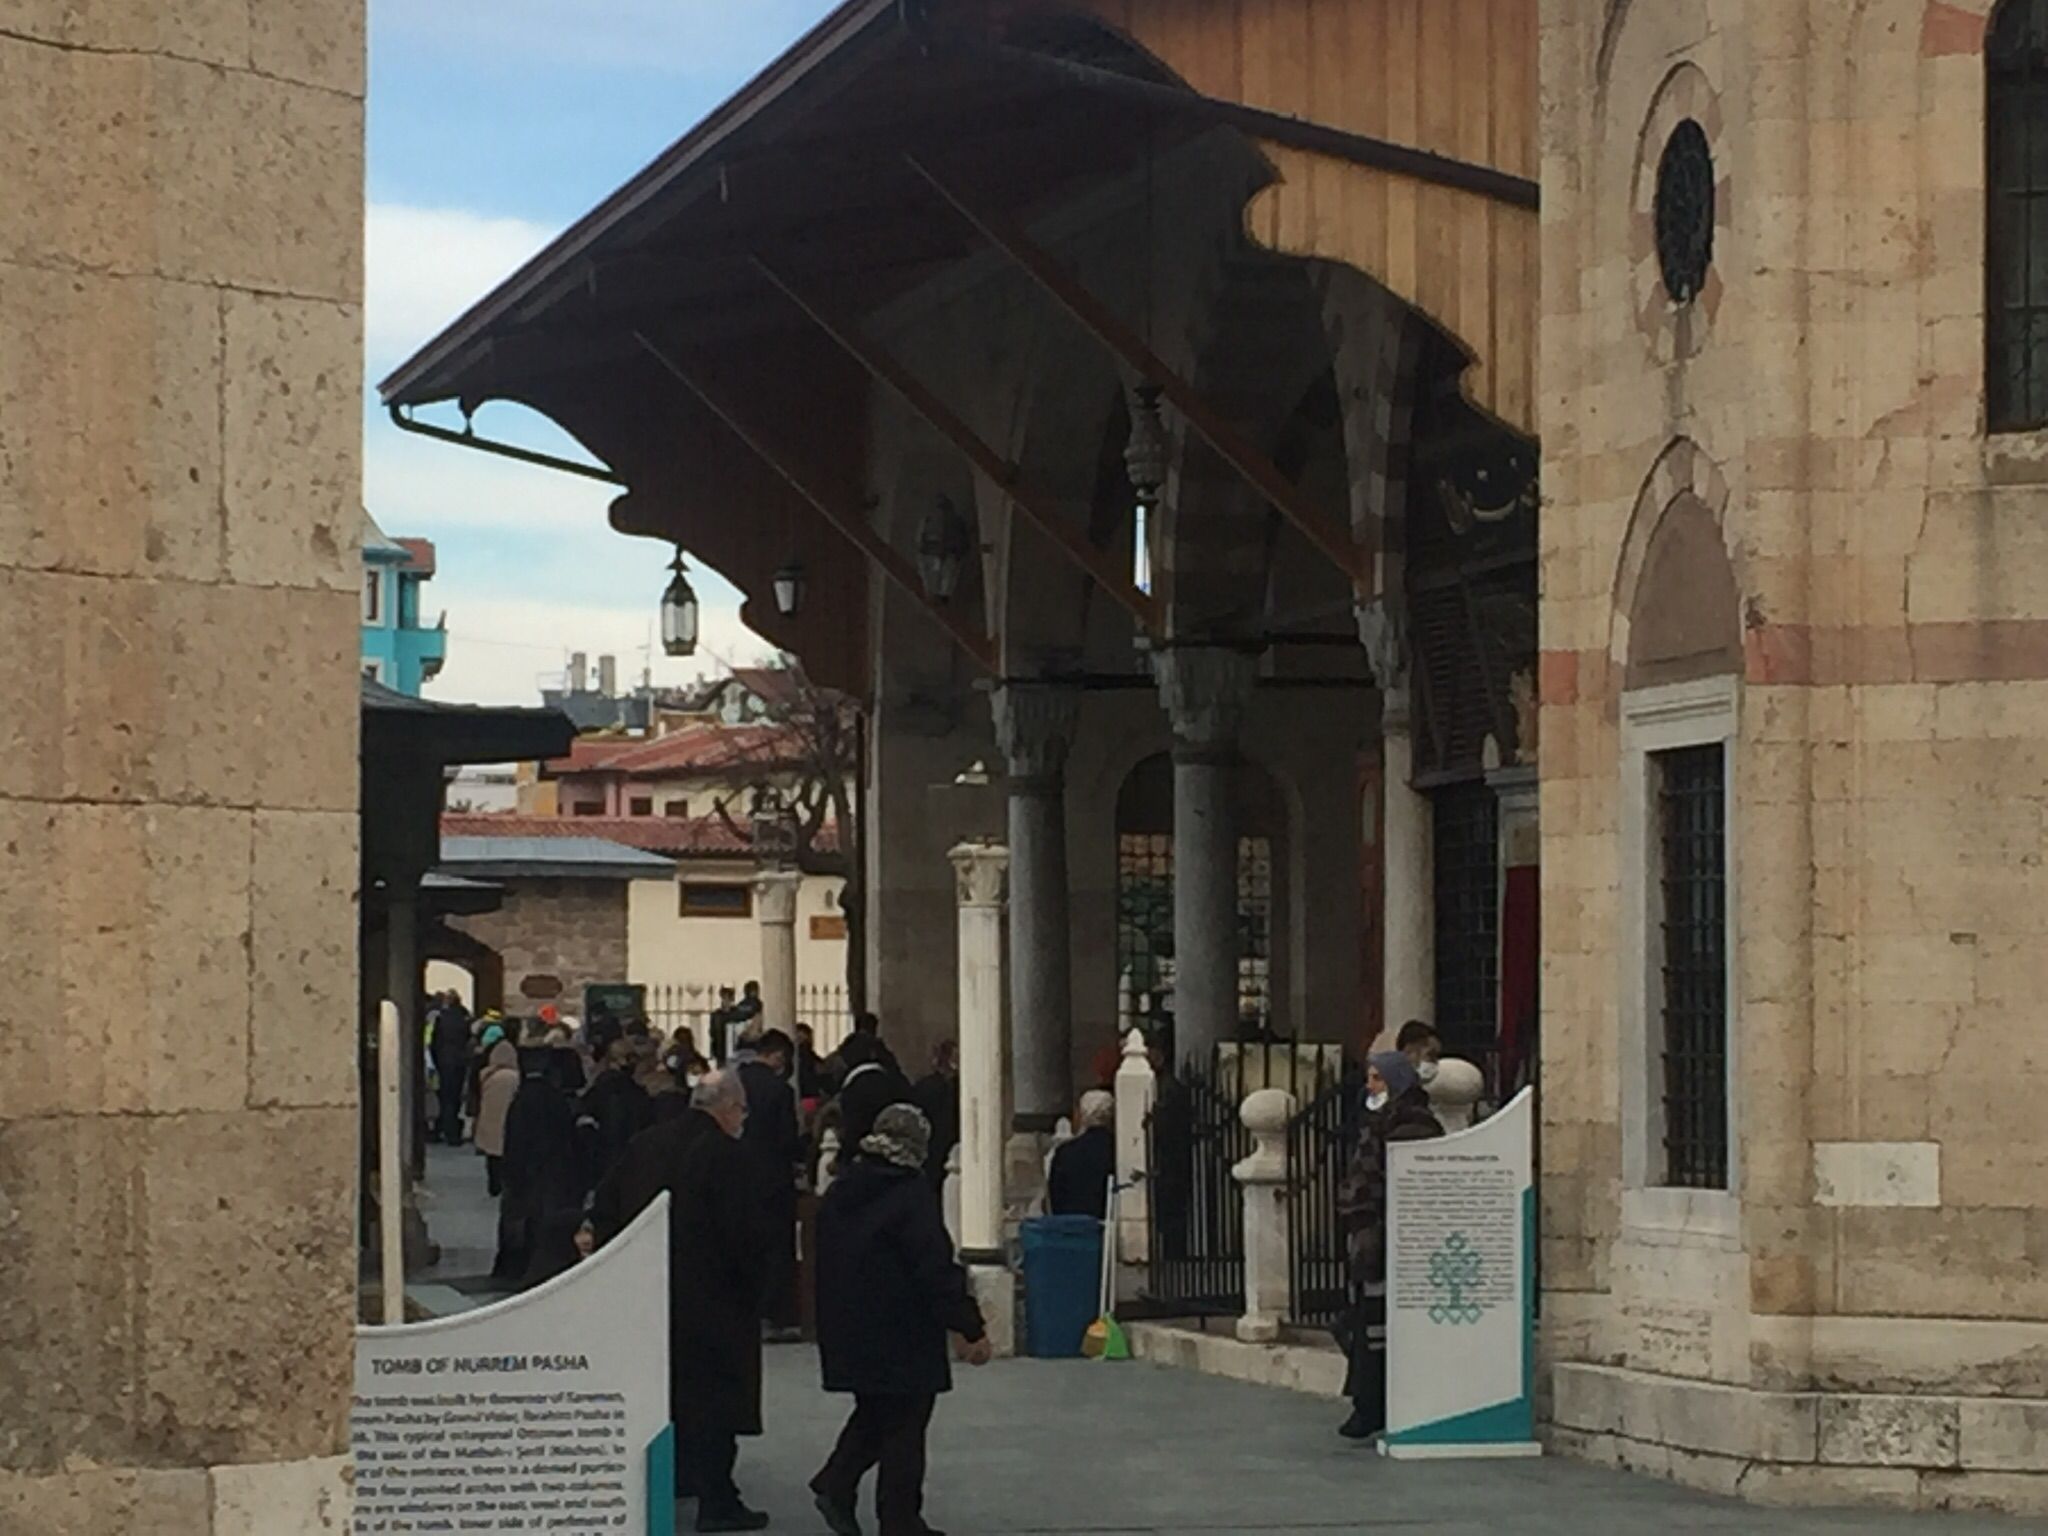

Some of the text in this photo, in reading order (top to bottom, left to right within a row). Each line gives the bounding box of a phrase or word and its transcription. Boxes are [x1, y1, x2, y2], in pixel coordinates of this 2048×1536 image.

[371, 1358, 422, 1375] TOMB
[426, 1357, 449, 1374] OF
[532, 1354, 589, 1371] PASHA
